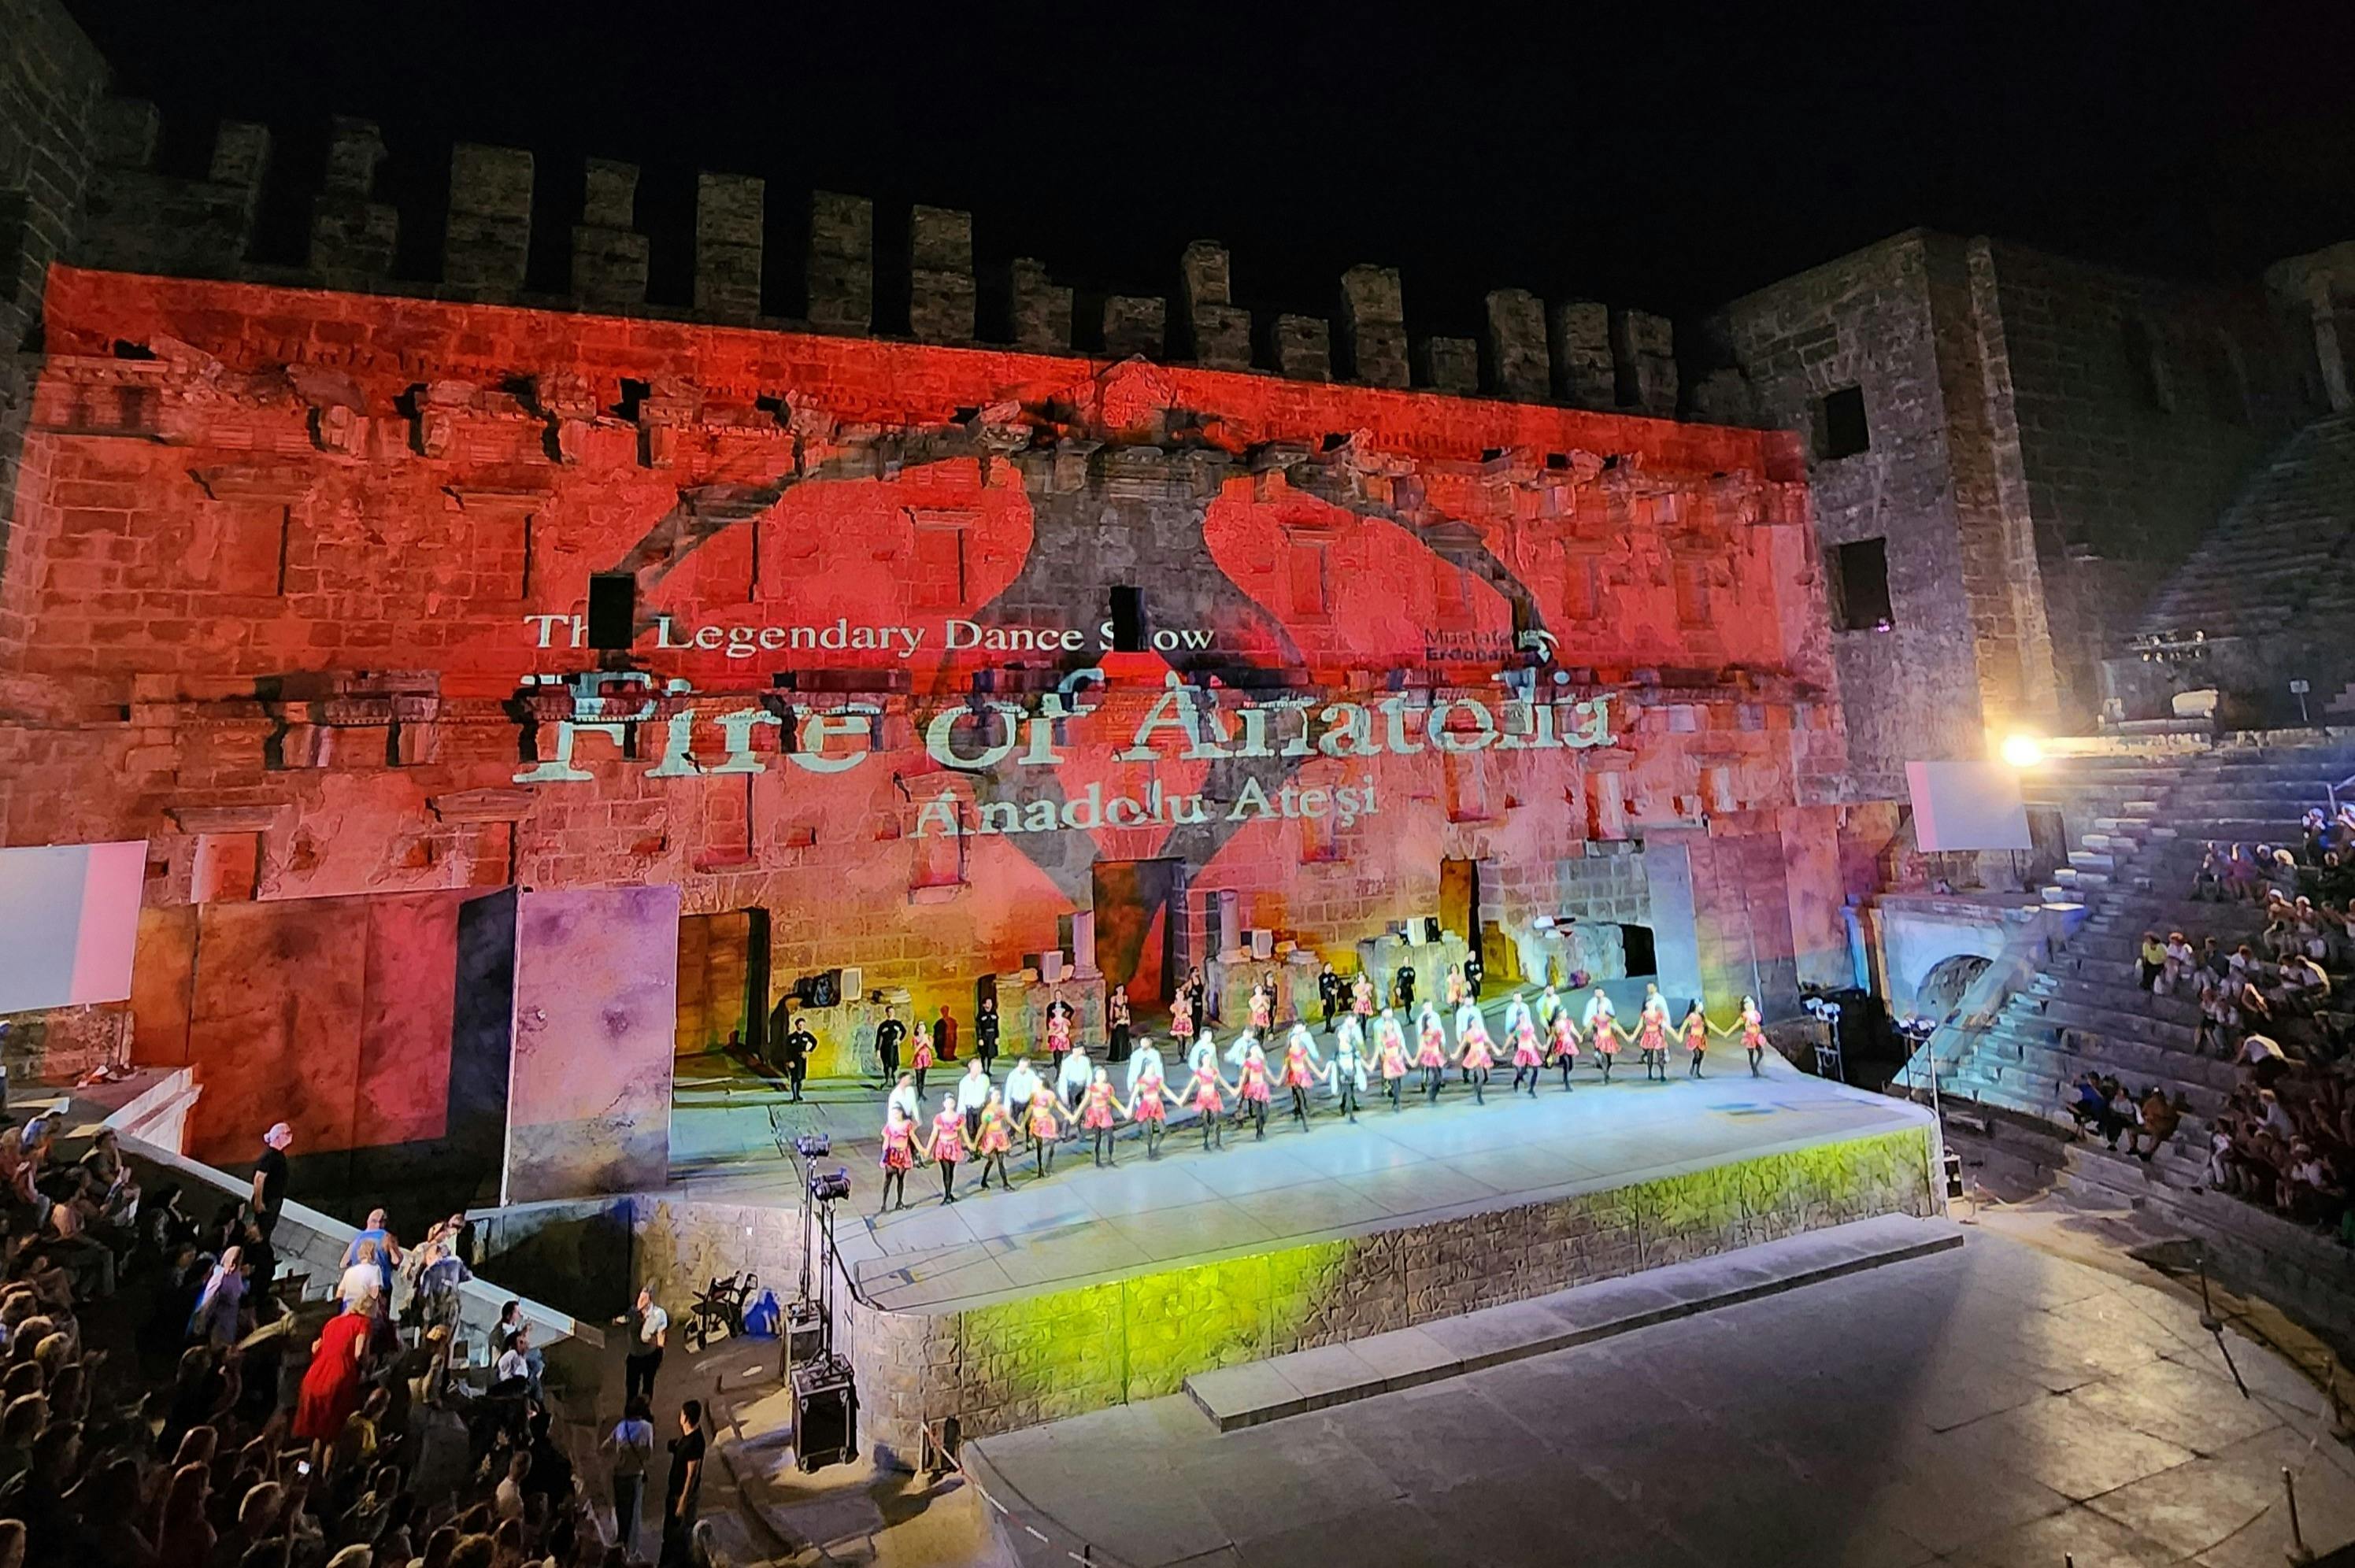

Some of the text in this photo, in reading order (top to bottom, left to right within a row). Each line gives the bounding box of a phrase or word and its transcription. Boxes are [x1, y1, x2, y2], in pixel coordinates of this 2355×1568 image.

[655, 616, 924, 658] Legendary
[946, 619, 1084, 651] Dance
[1099, 620, 1215, 651] Sow
[513, 667, 1619, 782] Fire of Anatolia
[907, 775, 1379, 838] Anadolu Ateşi
